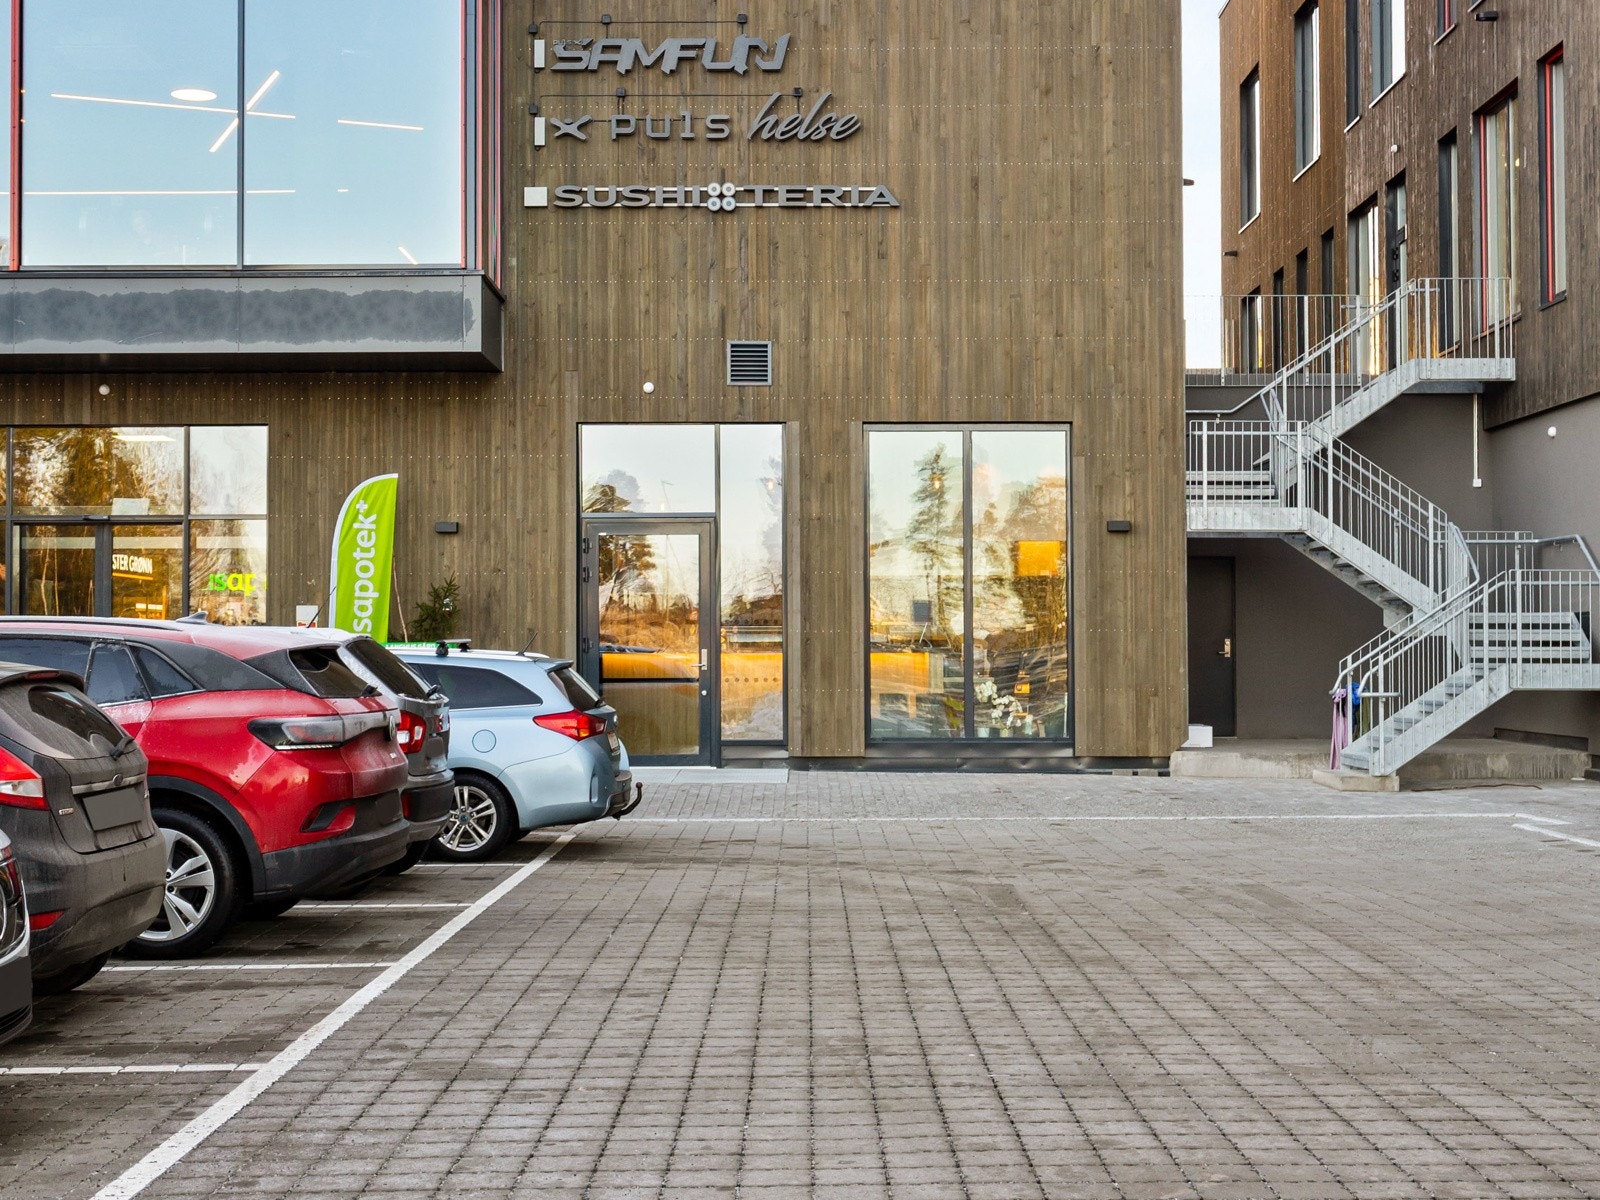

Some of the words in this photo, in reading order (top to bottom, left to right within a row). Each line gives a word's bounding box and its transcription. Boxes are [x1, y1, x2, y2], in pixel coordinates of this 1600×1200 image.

[550, 33, 792, 76] SAMFUN
[610, 110, 731, 141] puls
[746, 92, 861, 143] helse
